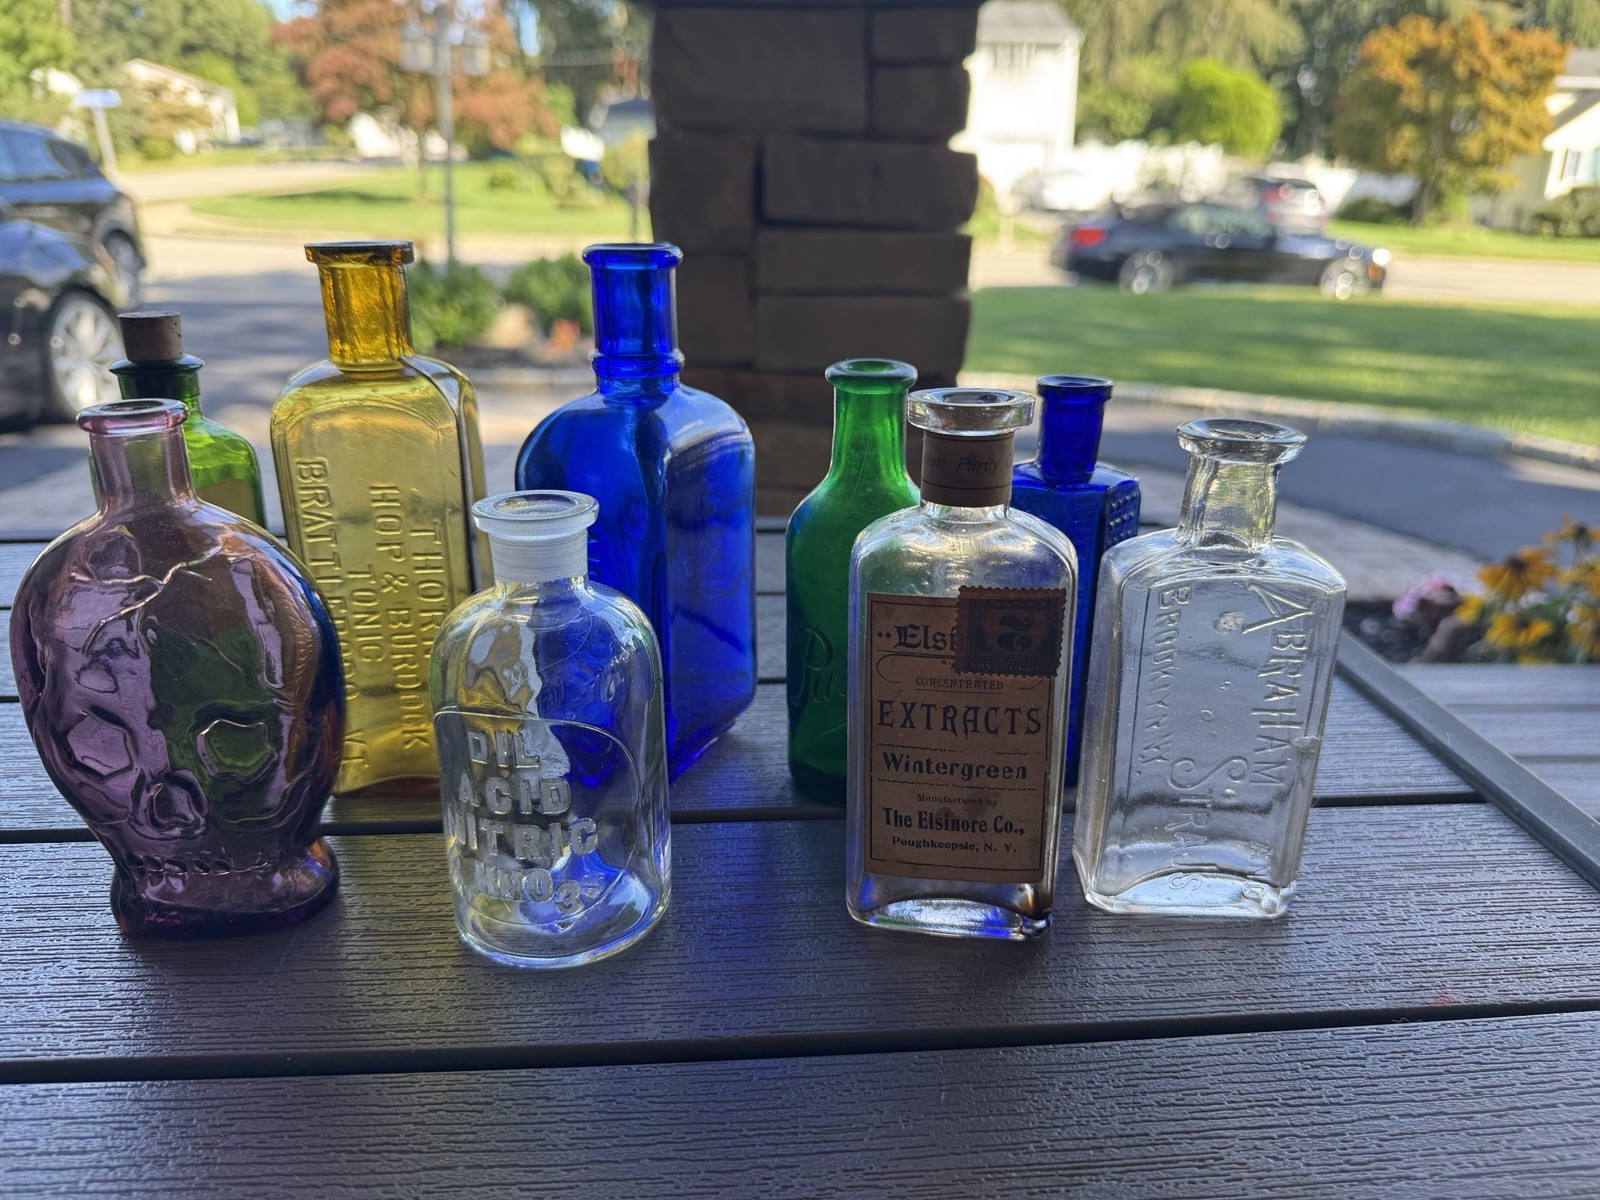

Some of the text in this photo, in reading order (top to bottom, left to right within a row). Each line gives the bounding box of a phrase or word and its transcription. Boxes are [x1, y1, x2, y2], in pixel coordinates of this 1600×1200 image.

[955, 456, 1000, 476] Purity
[347, 563, 387, 664] TONIC
[369, 486, 431, 750] HOP & BURDOCK
[915, 676, 1004, 691] CONCENTRATED
[1241, 582, 1315, 787] ABRAHAM
[877, 700, 1042, 739] EXTRACTS
[467, 728, 541, 770] DIL
[882, 752, 1028, 781] Wintergreen
[458, 772, 572, 816] ACID
[917, 793, 998, 808] Manufactured by
[882, 807, 1025, 836] The Elsinore Co.,
[892, 837, 1017, 853] Poughkeepsie, N. Y.
